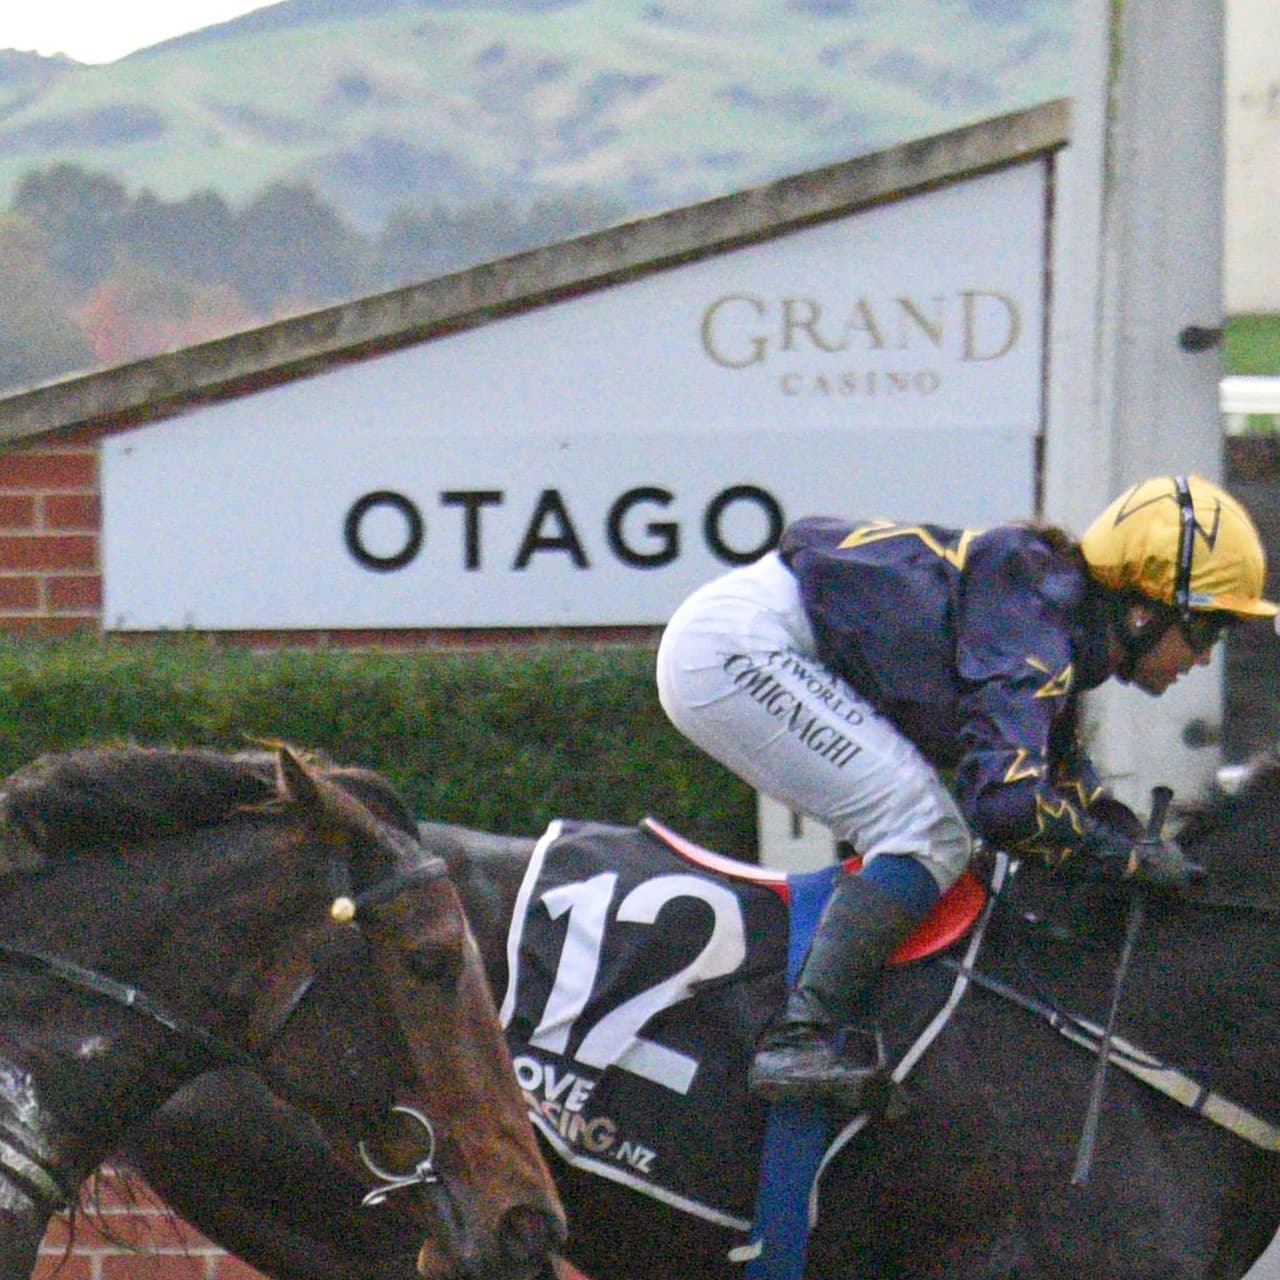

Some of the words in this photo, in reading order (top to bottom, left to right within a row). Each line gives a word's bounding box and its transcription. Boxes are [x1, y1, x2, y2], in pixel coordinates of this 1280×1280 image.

[700, 291, 1022, 369] GRAND
[779, 371, 941, 397] CASINO
[343, 483, 786, 572] OTAGO
[528, 872, 747, 1096] 12
[513, 1055, 595, 1112] OVE
